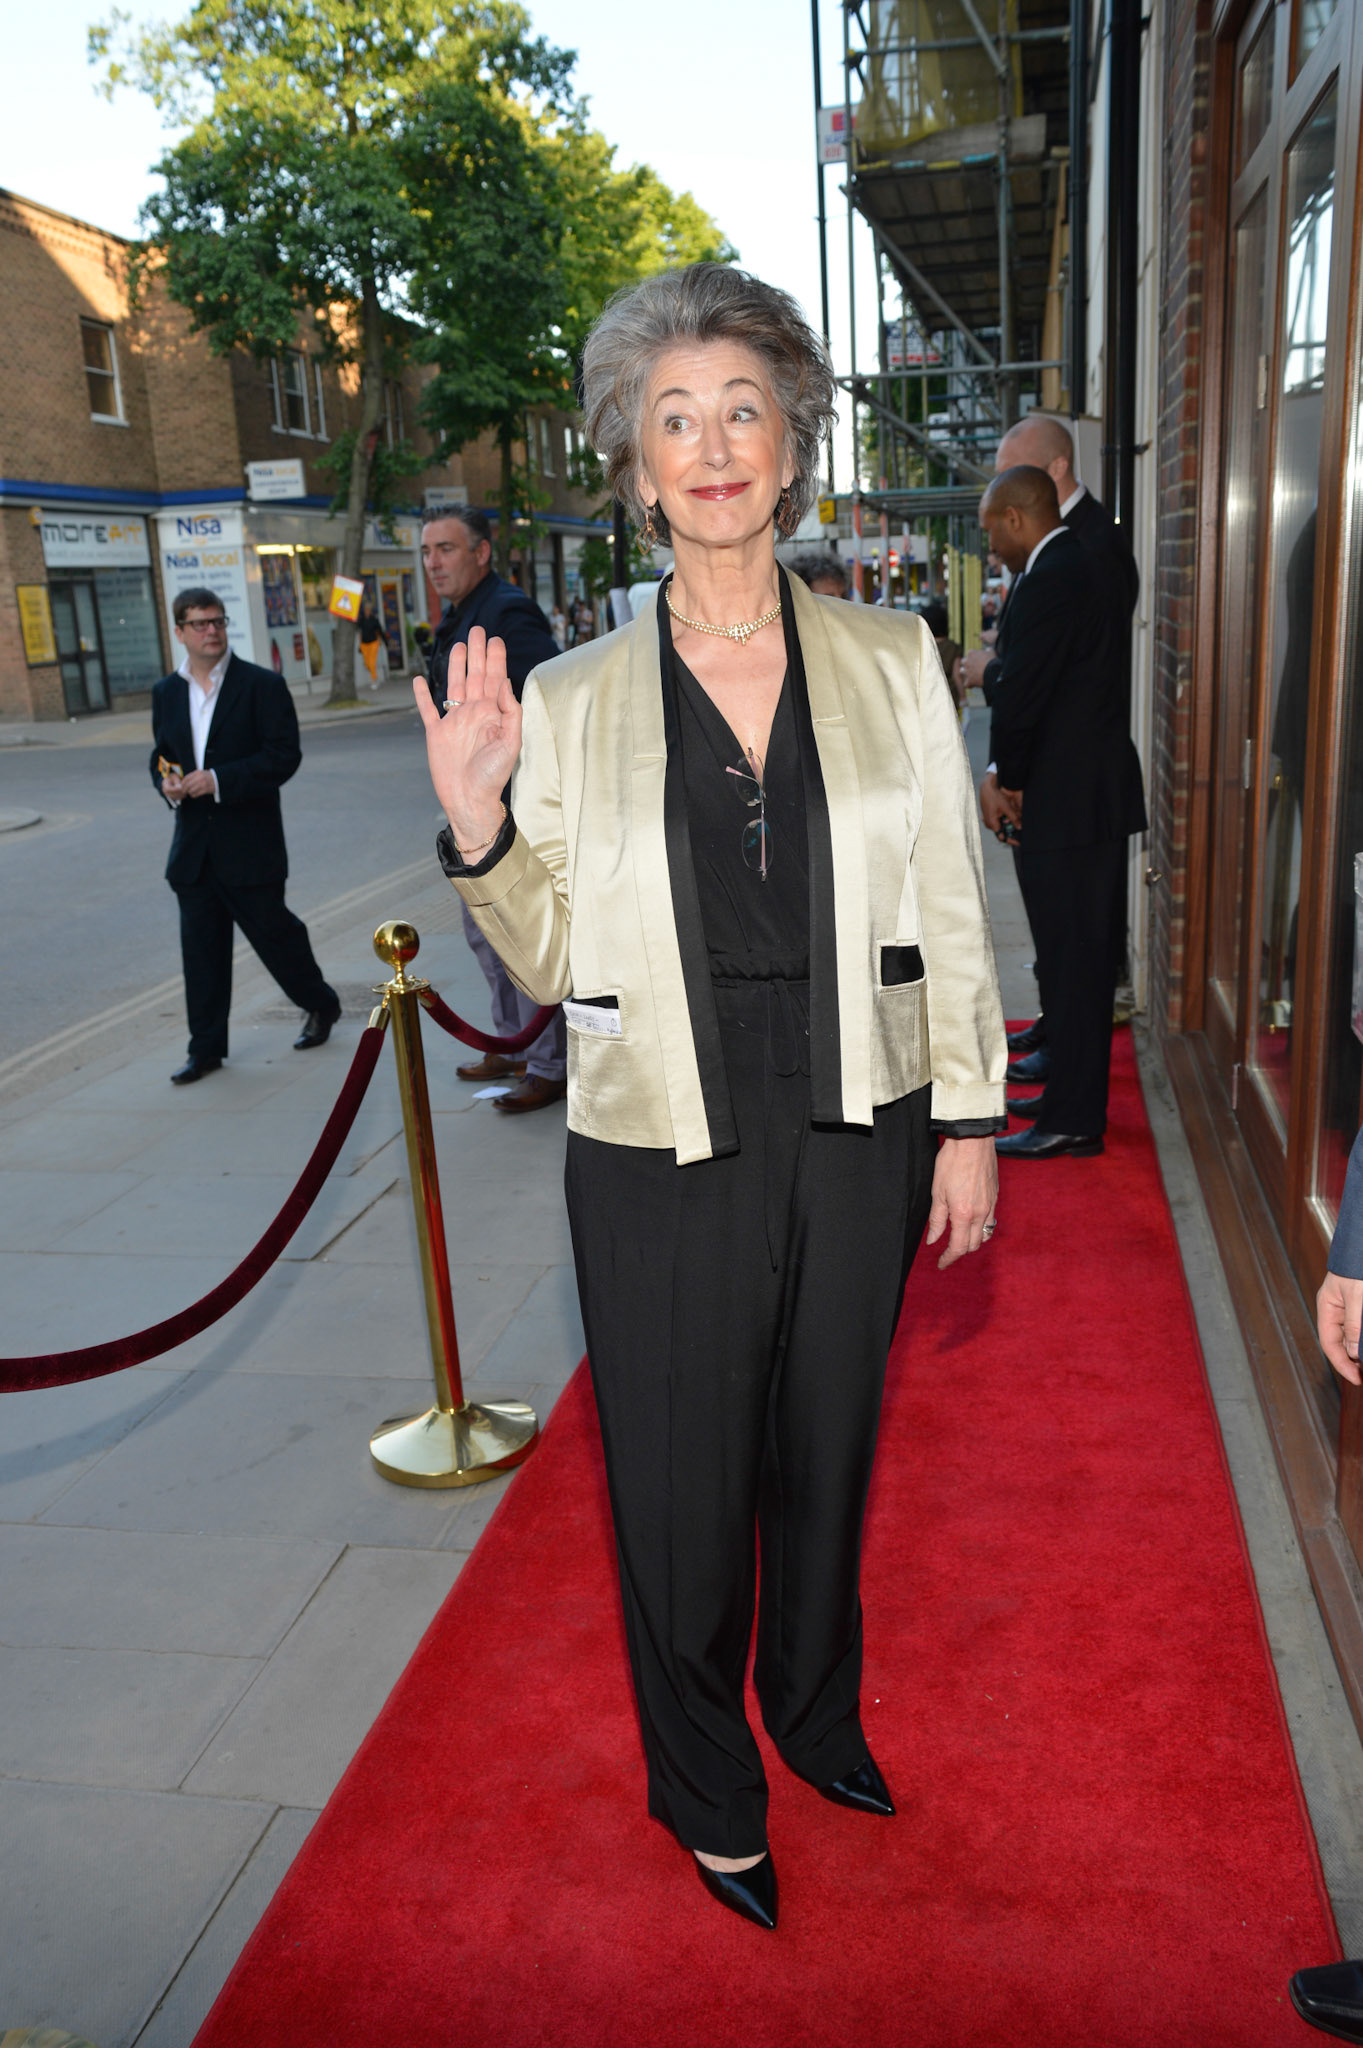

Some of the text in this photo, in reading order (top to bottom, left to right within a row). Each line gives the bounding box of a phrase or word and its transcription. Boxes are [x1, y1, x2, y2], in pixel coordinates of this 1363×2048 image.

[176, 514, 222, 536] Nisa
[165, 550, 239, 568] Nisa local
